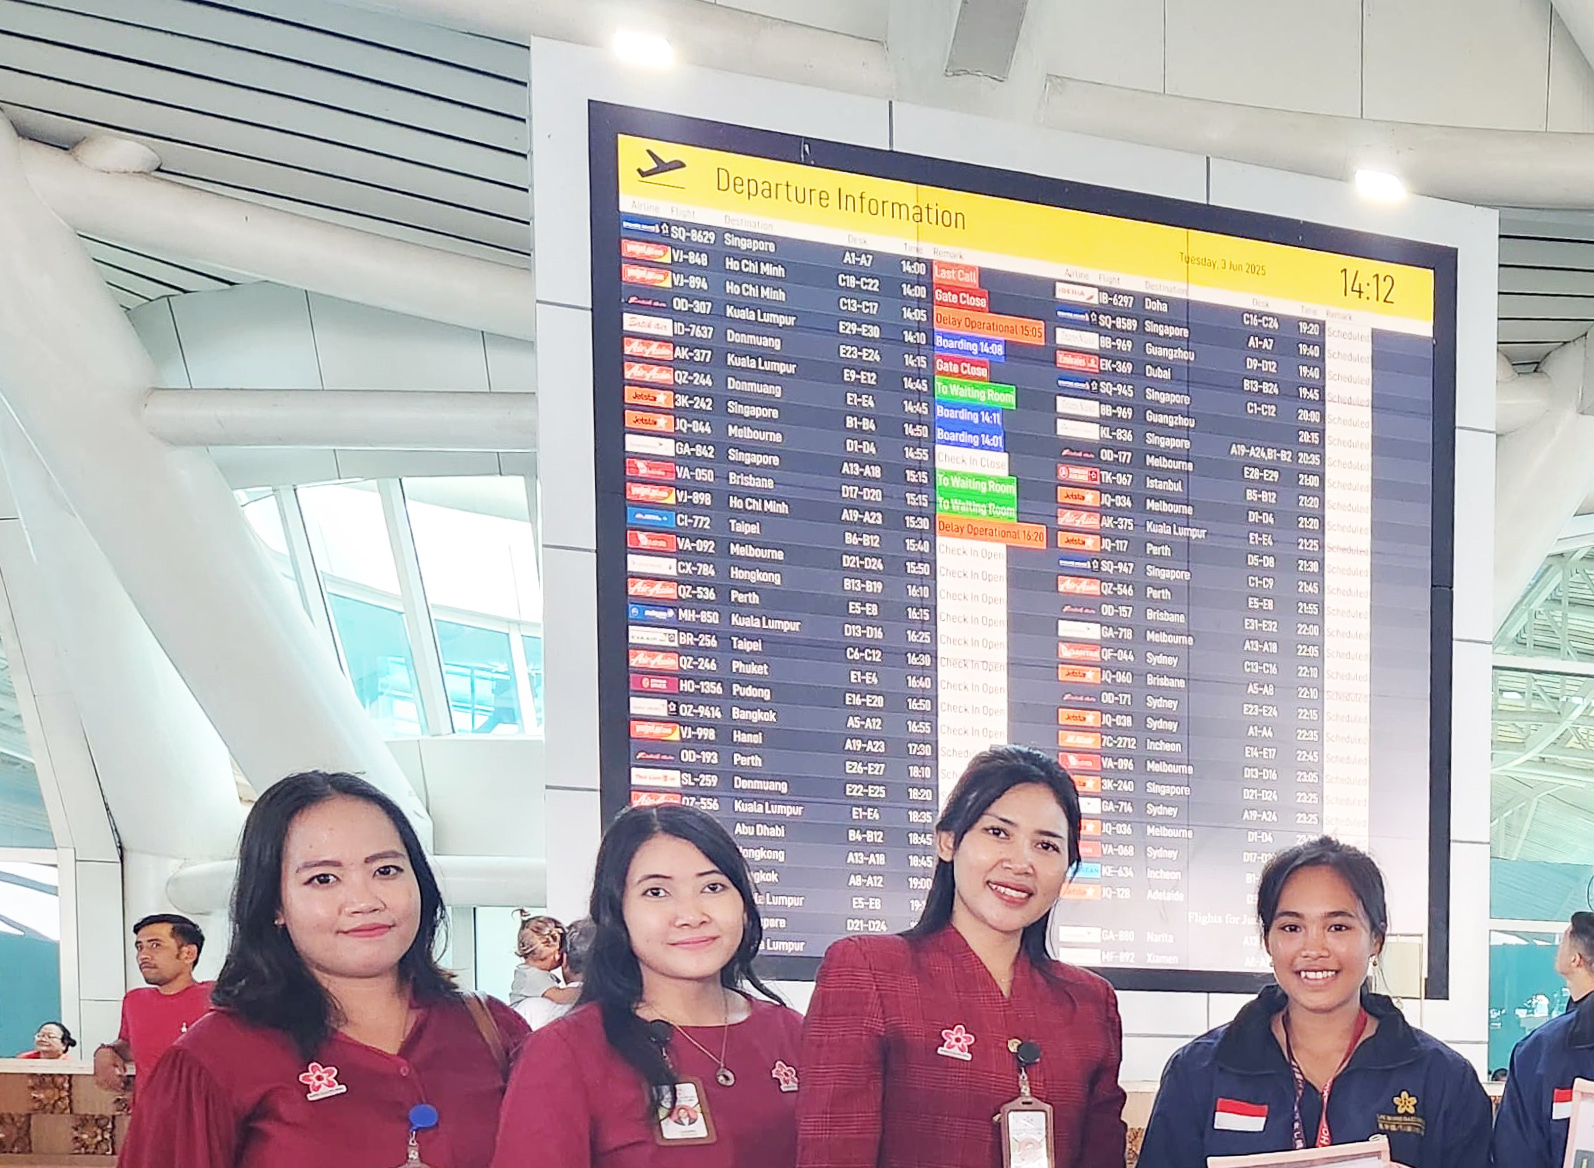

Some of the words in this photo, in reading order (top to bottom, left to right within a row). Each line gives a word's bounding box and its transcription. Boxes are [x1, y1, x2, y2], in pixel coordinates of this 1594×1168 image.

[716, 167, 829, 207] Departure
[838, 187, 966, 230] Information
[671, 206, 696, 220] Flight
[724, 215, 773, 231] Destination
[848, 234, 867, 245] Desk
[933, 248, 963, 260] Remark
[670, 225, 715, 244] SQ-8629
[724, 232, 775, 252] Singapore
[901, 260, 926, 275] 14:00
[935, 268, 954, 281] Last
[954, 270, 976, 283] Call
[1221, 260, 1227, 269] 3
[1229, 260, 1243, 273] Jun
[1246, 263, 1267, 276] 2025
[672, 249, 708, 266] VJ-848
[725, 258, 737, 271] Ho
[741, 260, 758, 274] Chi
[759, 262, 785, 278] Minh
[901, 283, 926, 299] 14:00
[935, 290, 957, 302] Gate
[959, 293, 986, 306] Close
[1340, 268, 1395, 304] 14:12
[672, 273, 708, 290] VJ-894
[902, 307, 927, 321] 14:05
[936, 311, 962, 328] Delay
[965, 317, 1018, 336] Operational
[1021, 325, 1042, 338] 15:05
[673, 298, 711, 314] OD-307
[726, 307, 756, 323] Kuala
[758, 311, 796, 328] Lumpur
[903, 330, 927, 345] 14:10
[936, 337, 978, 354] Boarding
[980, 342, 1003, 355] 14:08
[1145, 298, 1167, 312] Doha
[1327, 326, 1369, 344] Scheduled
[1145, 320, 1189, 338] Singapore
[674, 322, 713, 338] ID-7637
[727, 330, 781, 350] Donmuang
[904, 354, 927, 368] 14:15
[936, 360, 958, 372] Gate
[960, 363, 987, 376] Close
[1145, 343, 1195, 361] Guangzhou
[674, 346, 711, 362] AK-377
[727, 354, 756, 369] Kuala
[759, 357, 796, 375] Lumpur
[903, 377, 928, 392] 14:45
[936, 383, 948, 394] To
[949, 386, 986, 401] Waiting
[988, 390, 1014, 402] Room
[1146, 365, 1171, 380] Dubai
[674, 370, 712, 387] QZ-244
[727, 377, 781, 397] Donmuang
[937, 405, 978, 422] Boarding
[981, 411, 1000, 423] 14:11
[675, 394, 712, 411] 3K-242
[727, 401, 779, 419] Singapore
[904, 423, 929, 438] 14:50
[937, 429, 978, 446] Boarding
[981, 434, 1002, 447] 14:01
[1146, 410, 1195, 428] Guangzhou
[675, 418, 712, 434] JQ-044
[728, 425, 782, 442] Melbourne
[938, 452, 966, 465] Check
[969, 455, 977, 465] In
[980, 456, 1006, 470] Close
[676, 442, 715, 458] GA-842
[728, 449, 779, 466] Singapore
[905, 469, 928, 483] 15:15
[1146, 456, 1193, 471] Melbourne
[676, 466, 714, 482] VA-050
[729, 472, 774, 489] Brisbane
[1146, 478, 1183, 492] Istanbul
[677, 490, 711, 505] VJ-898
[939, 521, 964, 536] Delay
[967, 524, 1019, 541] Operational
[1022, 530, 1044, 542] 16:20
[677, 514, 711, 529] CI-772
[729, 519, 760, 535] Taipei
[905, 539, 929, 553] 15:40
[1146, 521, 1171, 536] Kuala
[1173, 524, 1207, 540] Lumpur
[677, 538, 715, 553] VA-092
[730, 544, 784, 560] Melbourne
[730, 567, 781, 585] Hongkong
[906, 585, 929, 599] 16:10
[731, 590, 759, 604] Perth
[1147, 586, 1171, 600] Perth
[679, 608, 719, 624] MH-850
[1147, 608, 1185, 623] Brisbane
[680, 632, 717, 647] BR-256
[732, 661, 768, 676] Phuket
[1146, 652, 1178, 667] Sydney
[732, 684, 771, 701] Pudong
[680, 703, 722, 719] OZ-9414
[732, 707, 776, 723] Bangkok
[733, 731, 762, 744] Hanoi
[1147, 738, 1181, 752] Incheon
[681, 749, 718, 764] OD-193
[734, 776, 788, 793] Donmuang
[735, 823, 755, 836] Abu
[757, 823, 785, 837] Dhabi
[1147, 890, 1184, 901] Adelaide
